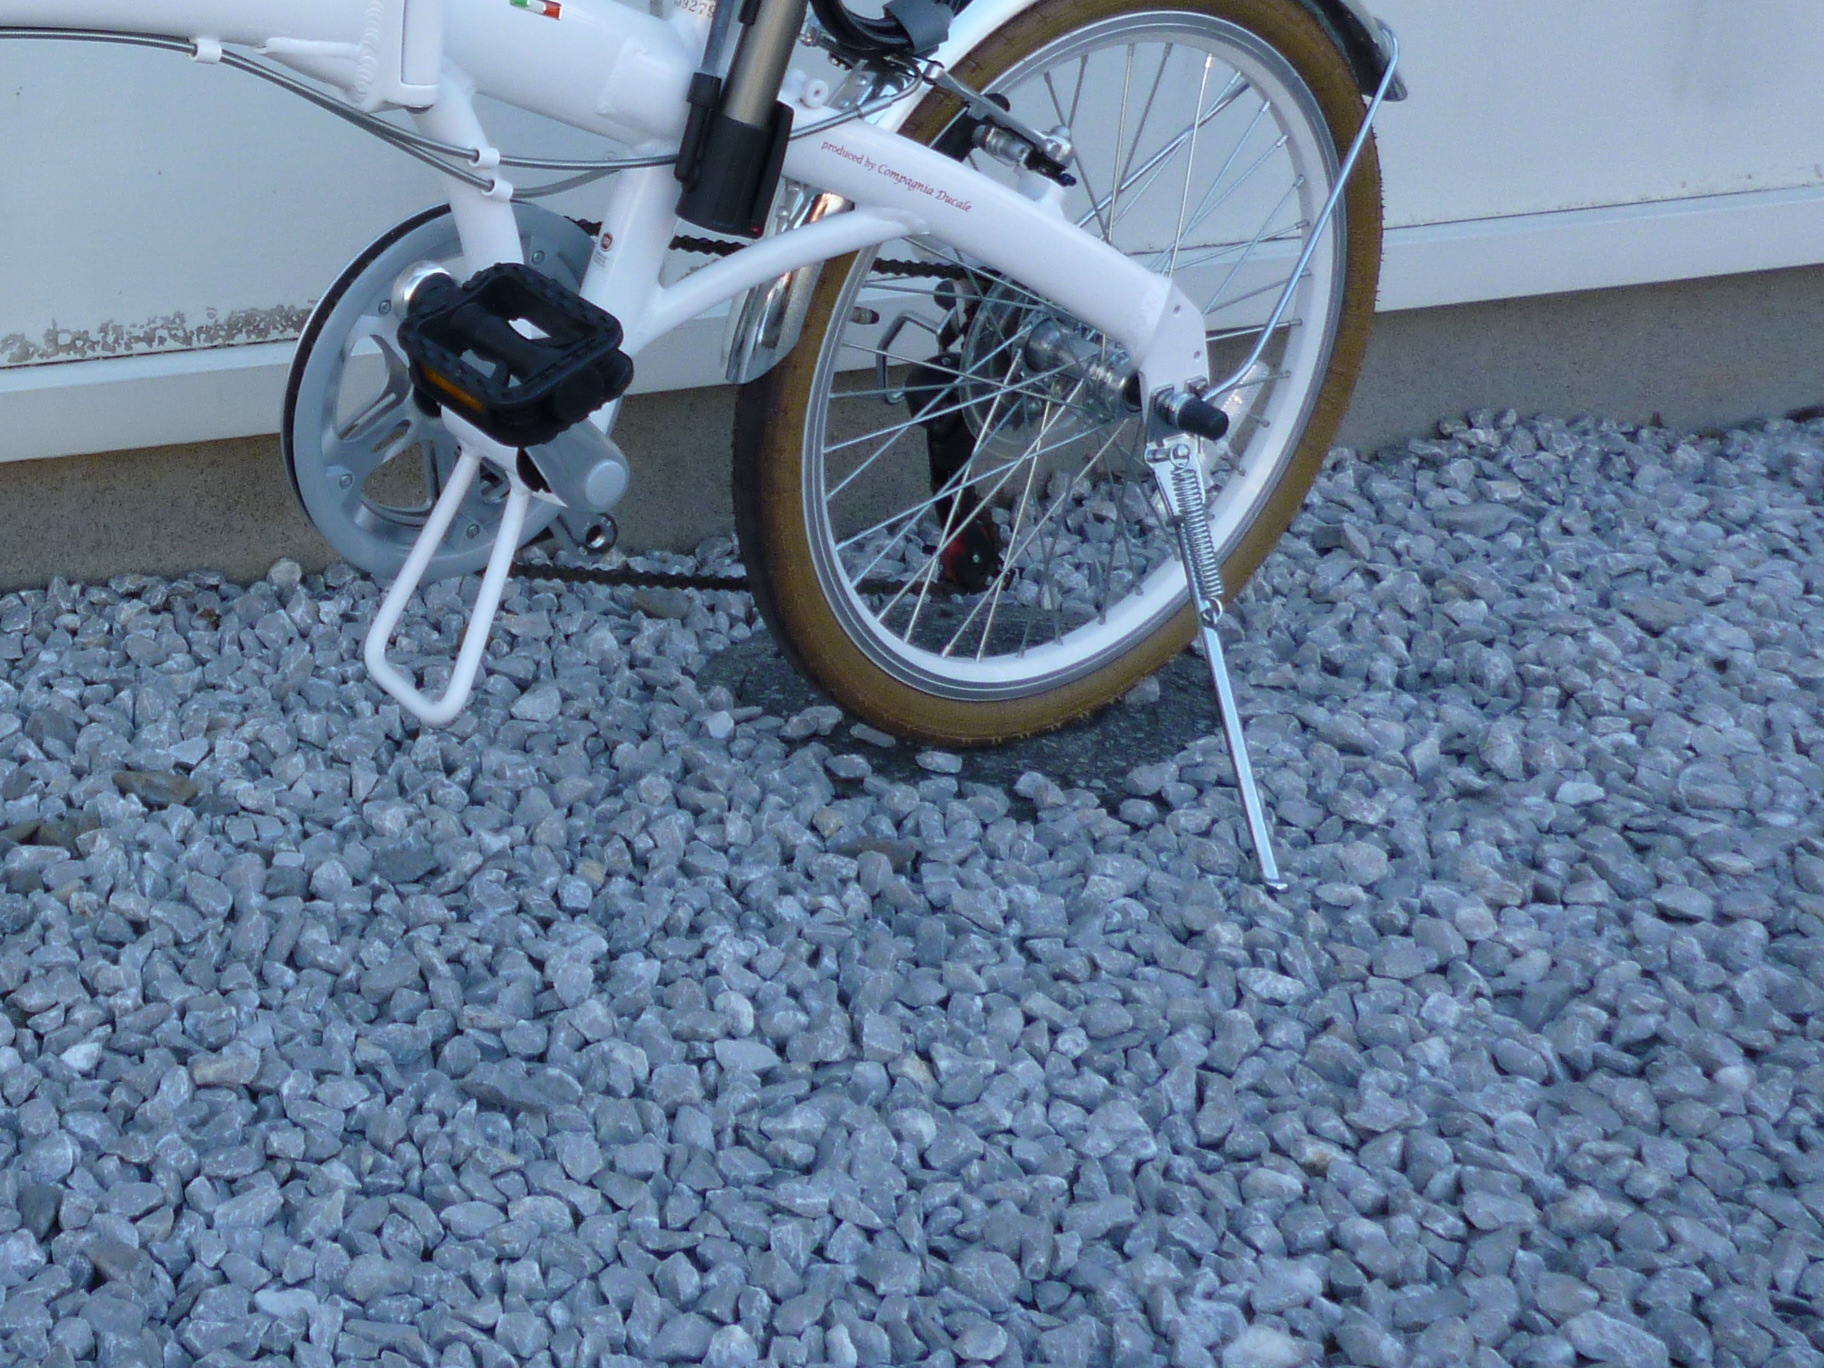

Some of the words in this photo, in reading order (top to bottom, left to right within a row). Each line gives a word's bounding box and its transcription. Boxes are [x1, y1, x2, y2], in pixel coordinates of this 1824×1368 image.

[821, 140, 864, 165] produced
[864, 157, 877, 172] by
[877, 163, 934, 196] Compagnia
[935, 189, 973, 213] Ducale
